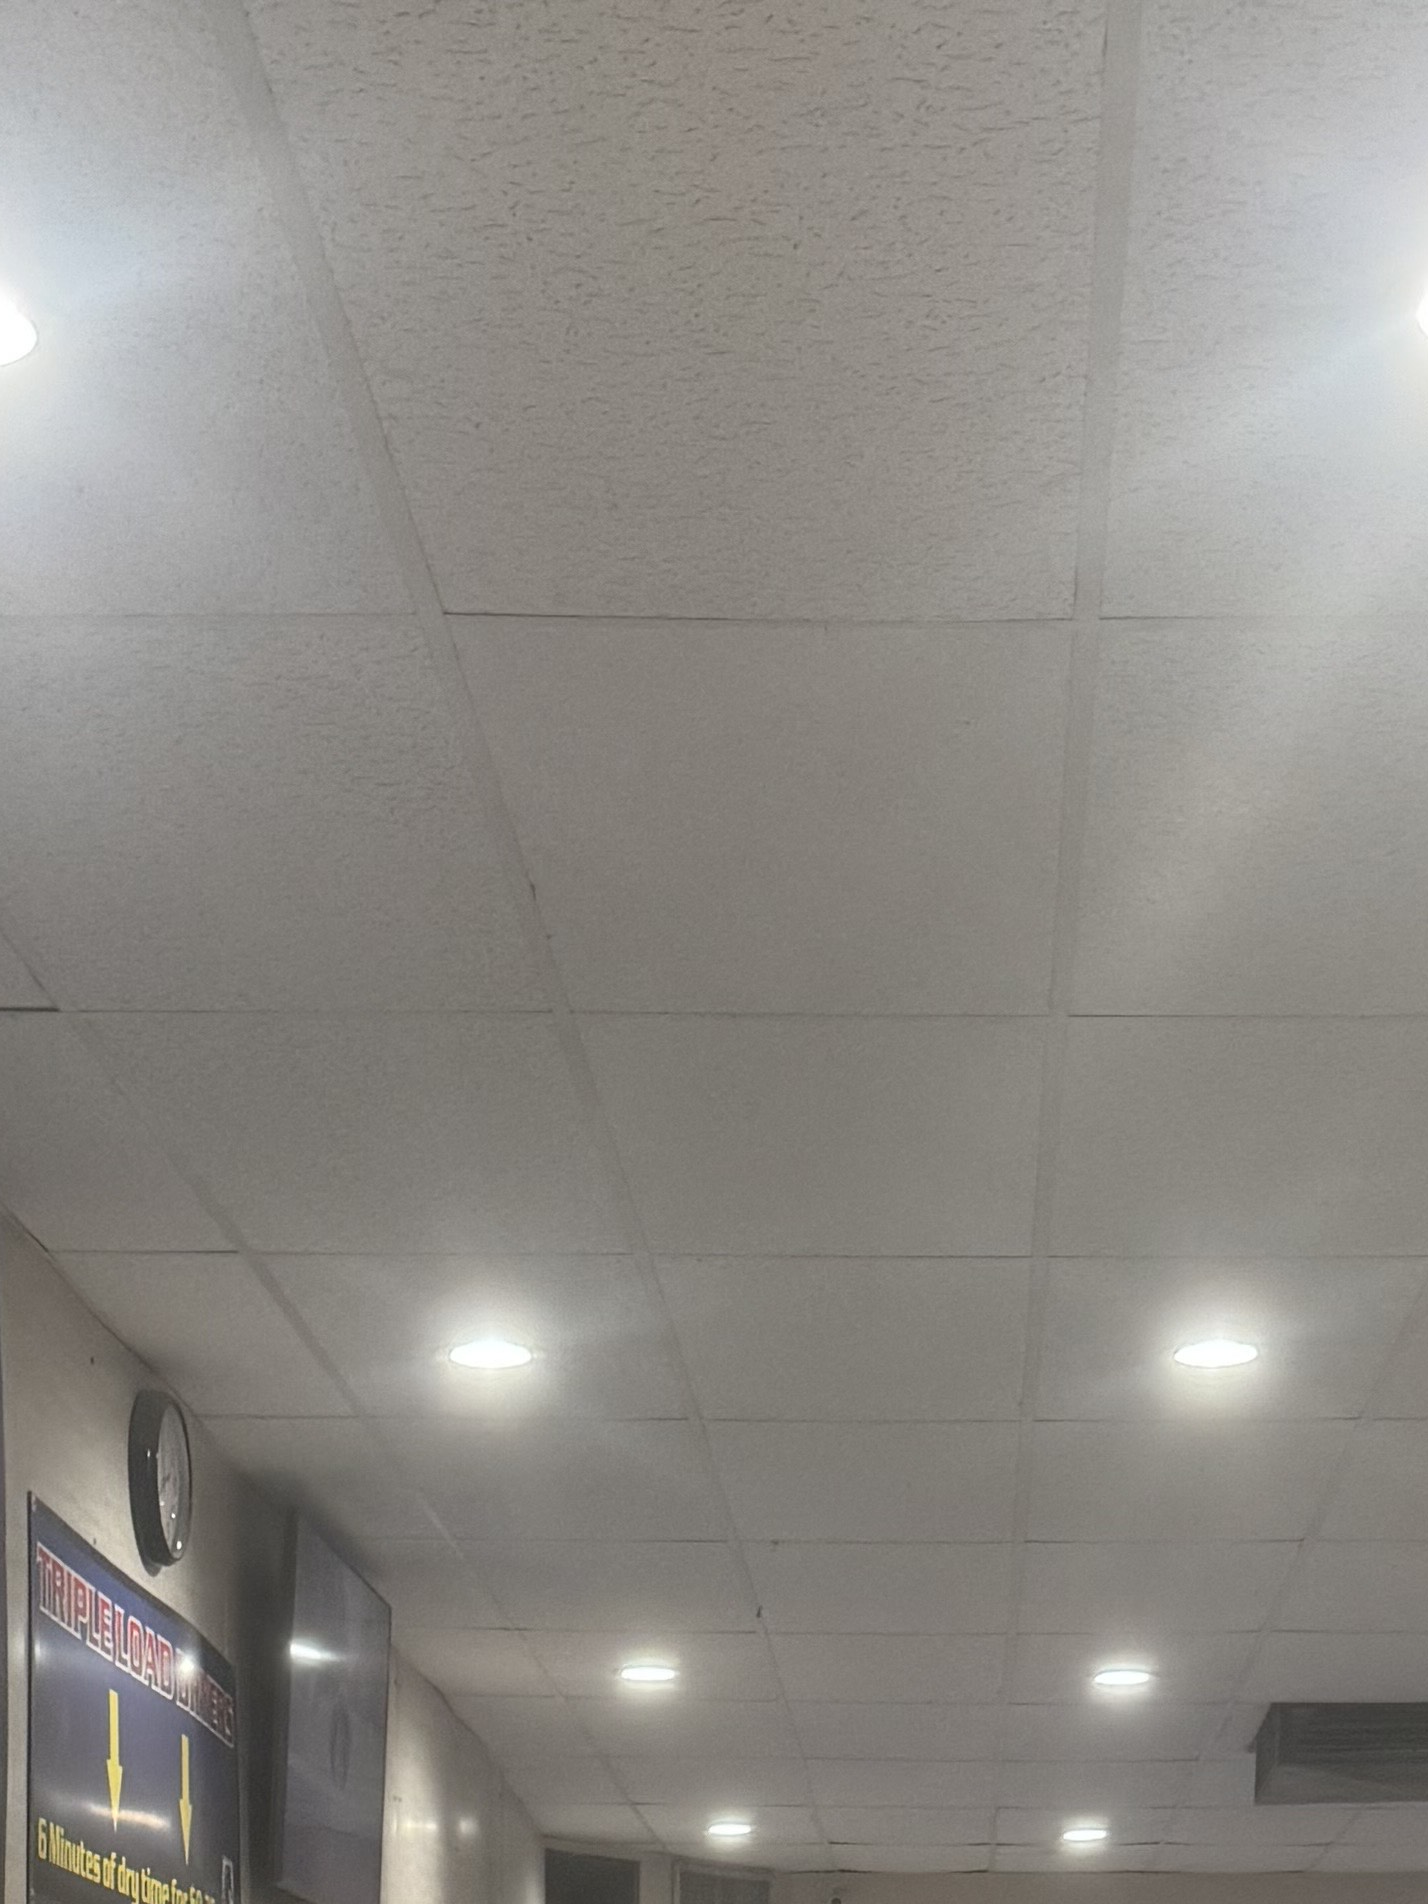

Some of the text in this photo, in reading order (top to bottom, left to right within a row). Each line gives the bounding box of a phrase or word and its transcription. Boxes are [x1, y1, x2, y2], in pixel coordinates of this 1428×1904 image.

[36, 1541, 114, 1663] TRIPLE
[114, 1603, 174, 1700] LOAD
[38, 1817, 48, 1860] 6
[49, 1822, 101, 1884] Minutes
[102, 1852, 117, 1890] of
